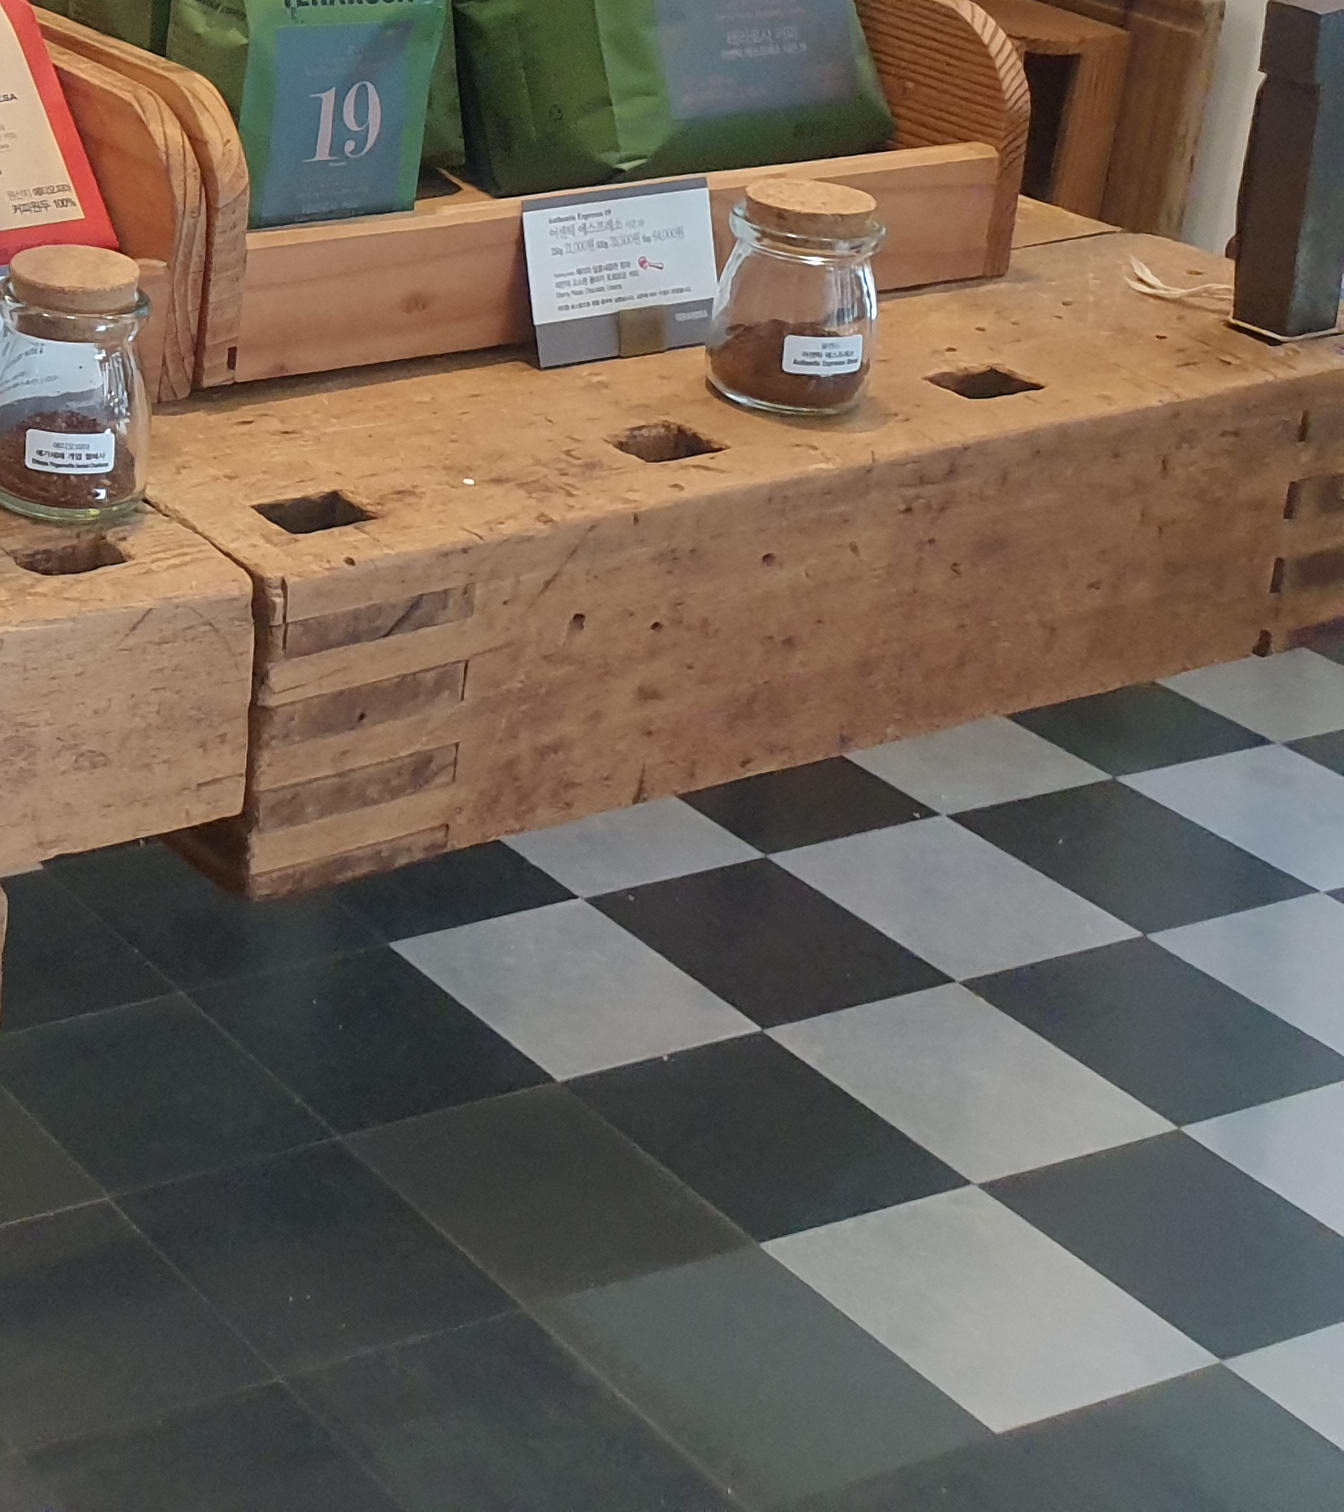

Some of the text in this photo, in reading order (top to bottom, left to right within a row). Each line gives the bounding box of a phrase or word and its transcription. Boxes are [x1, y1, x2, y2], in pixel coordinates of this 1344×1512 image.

[302, 81, 381, 162] 19
[12, 197, 76, 214] 커피원두 100%
